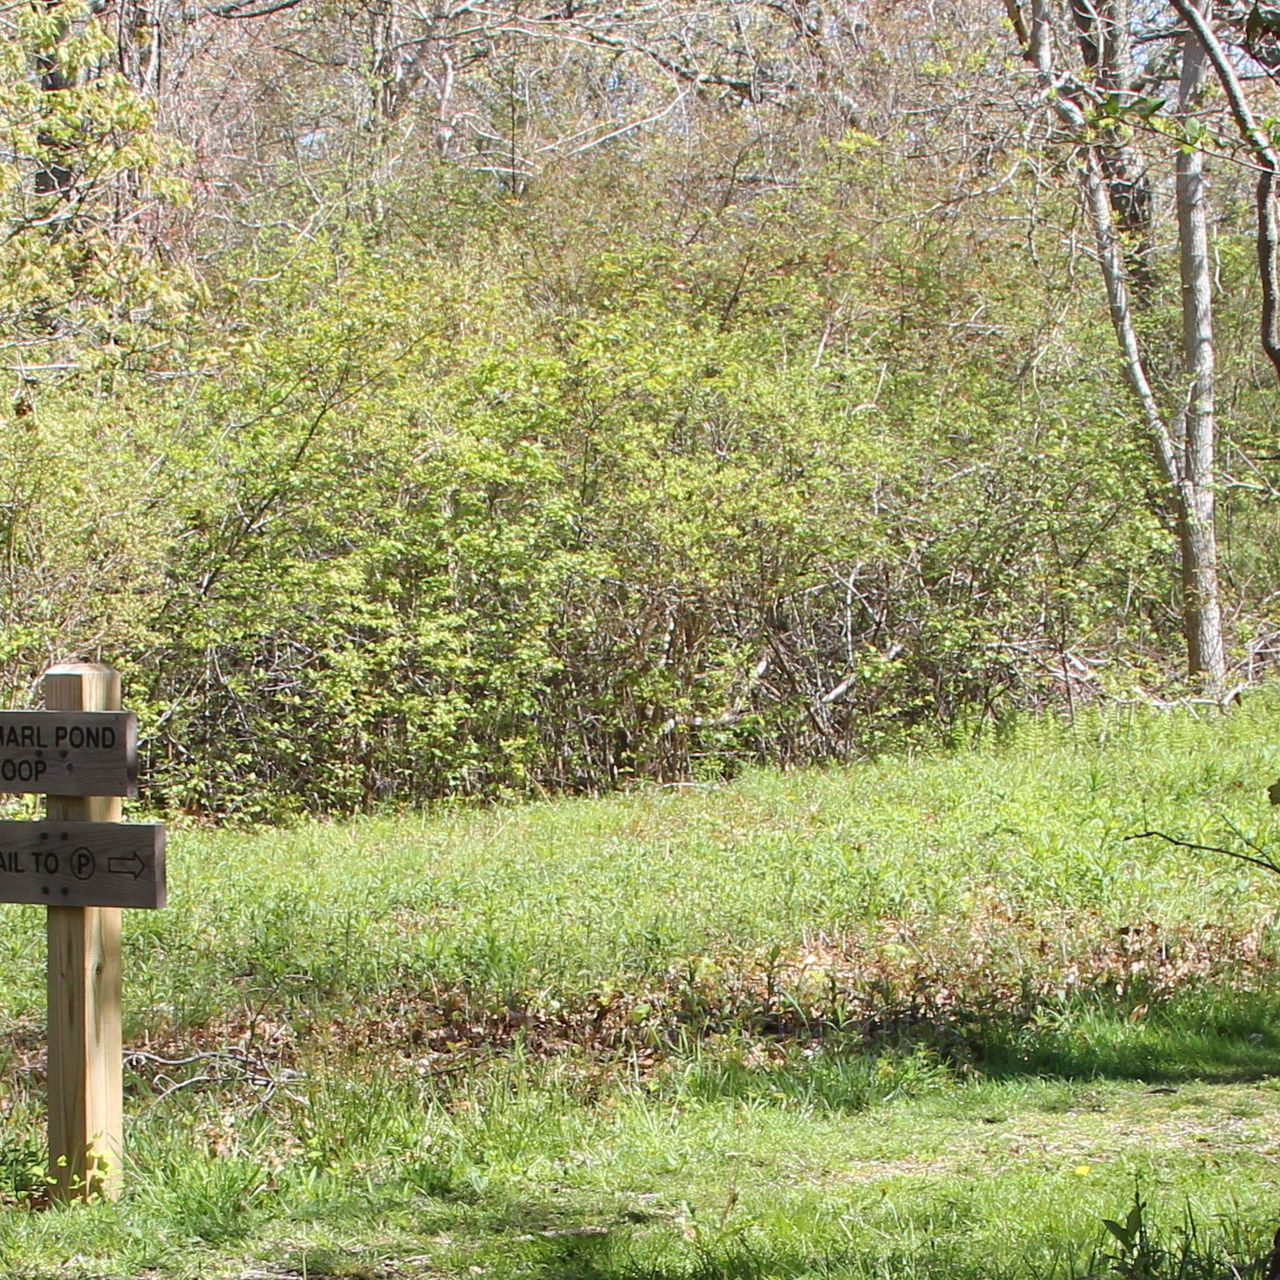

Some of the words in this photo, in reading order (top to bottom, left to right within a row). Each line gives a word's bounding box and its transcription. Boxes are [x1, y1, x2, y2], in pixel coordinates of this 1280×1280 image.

[55, 726, 115, 749] POND
[31, 852, 59, 874] TO
[77, 853, 91, 875] P
